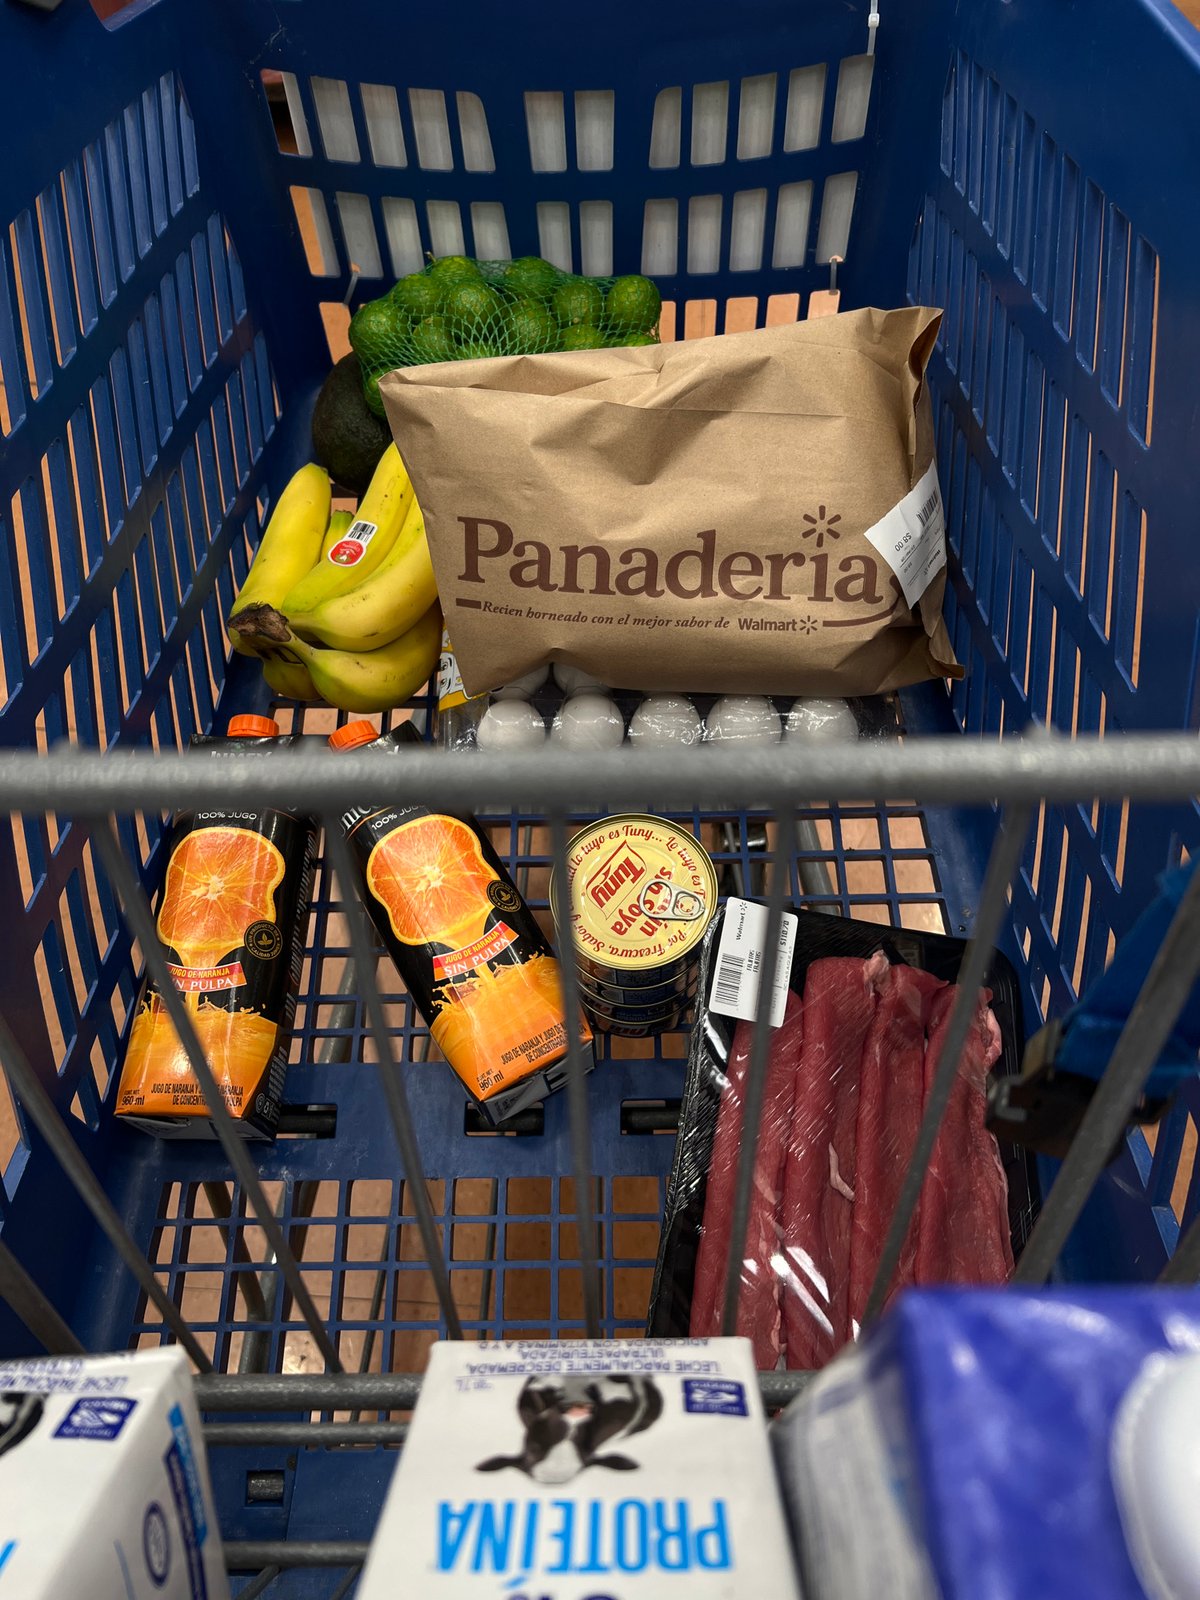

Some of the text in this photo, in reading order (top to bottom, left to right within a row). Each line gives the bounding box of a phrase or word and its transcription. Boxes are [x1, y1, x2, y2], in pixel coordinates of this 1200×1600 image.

[894, 532, 912, 552] $8.00
[482, 601, 523, 616] Recien
[591, 614, 614, 625] con
[617, 613, 631, 626] el
[632, 615, 673, 629] mejor
[674, 616, 712, 629] sabor
[714, 616, 731, 629] de
[738, 617, 798, 632] Walmart
[198, 812, 258, 820] 100% JUGO
[371, 812, 398, 830] 100%
[608, 829, 620, 840] es
[581, 835, 606, 855] tuyo
[665, 836, 678, 852] Lo
[677, 848, 698, 872] tuyo
[590, 856, 646, 909] Tuny
[691, 873, 702, 886] es
[573, 924, 605, 953] Sabor
[667, 929, 687, 947] Por
[443, 934, 510, 977] SIN PULPA
[445, 931, 500, 964] JUGO DE NARANJA
[608, 943, 666, 958] Frescura,
[187, 970, 197, 978] DE
[198, 967, 230, 979] NARANJA
[190, 977, 234, 991] PULPA
[501, 1050, 515, 1065] JUGO
[511, 1046, 521, 1059] DE
[519, 1035, 543, 1056] NARANJA
[525, 1052, 536, 1063] DE
[150, 1083, 164, 1094] JUGO
[164, 1083, 172, 1094] DE
[172, 1083, 195, 1095] NARANJA
[194, 1084, 199, 1095] Y
[479, 1070, 505, 1092] 960 ml
[121, 1095, 145, 1106] 960 ml
[172, 1094, 180, 1106] DE
[566, 1360, 671, 1372] PARCIALMENTE
[674, 1360, 720, 1372] LECHE
[437, 1499, 733, 1588] PROTEÍNA
